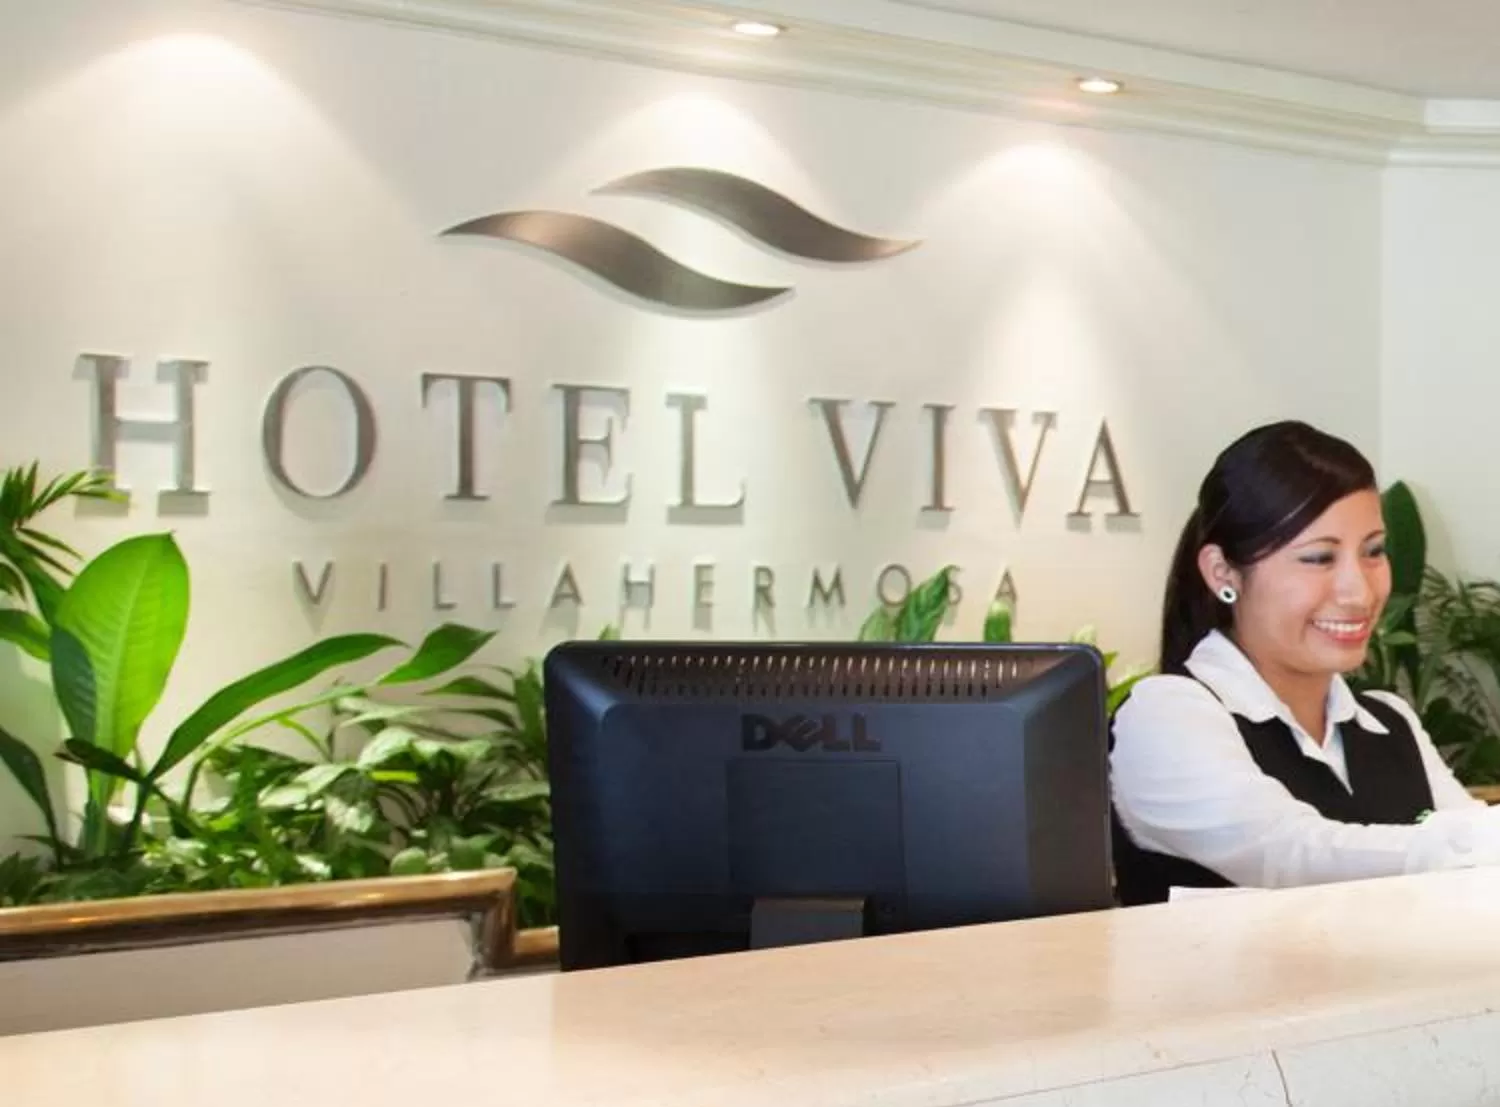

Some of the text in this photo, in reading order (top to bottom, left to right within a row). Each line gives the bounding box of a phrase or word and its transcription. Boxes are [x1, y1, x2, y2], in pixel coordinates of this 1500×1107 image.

[76, 352, 1141, 518] HOTEL VIVA
[741, 713, 882, 752] DELL
